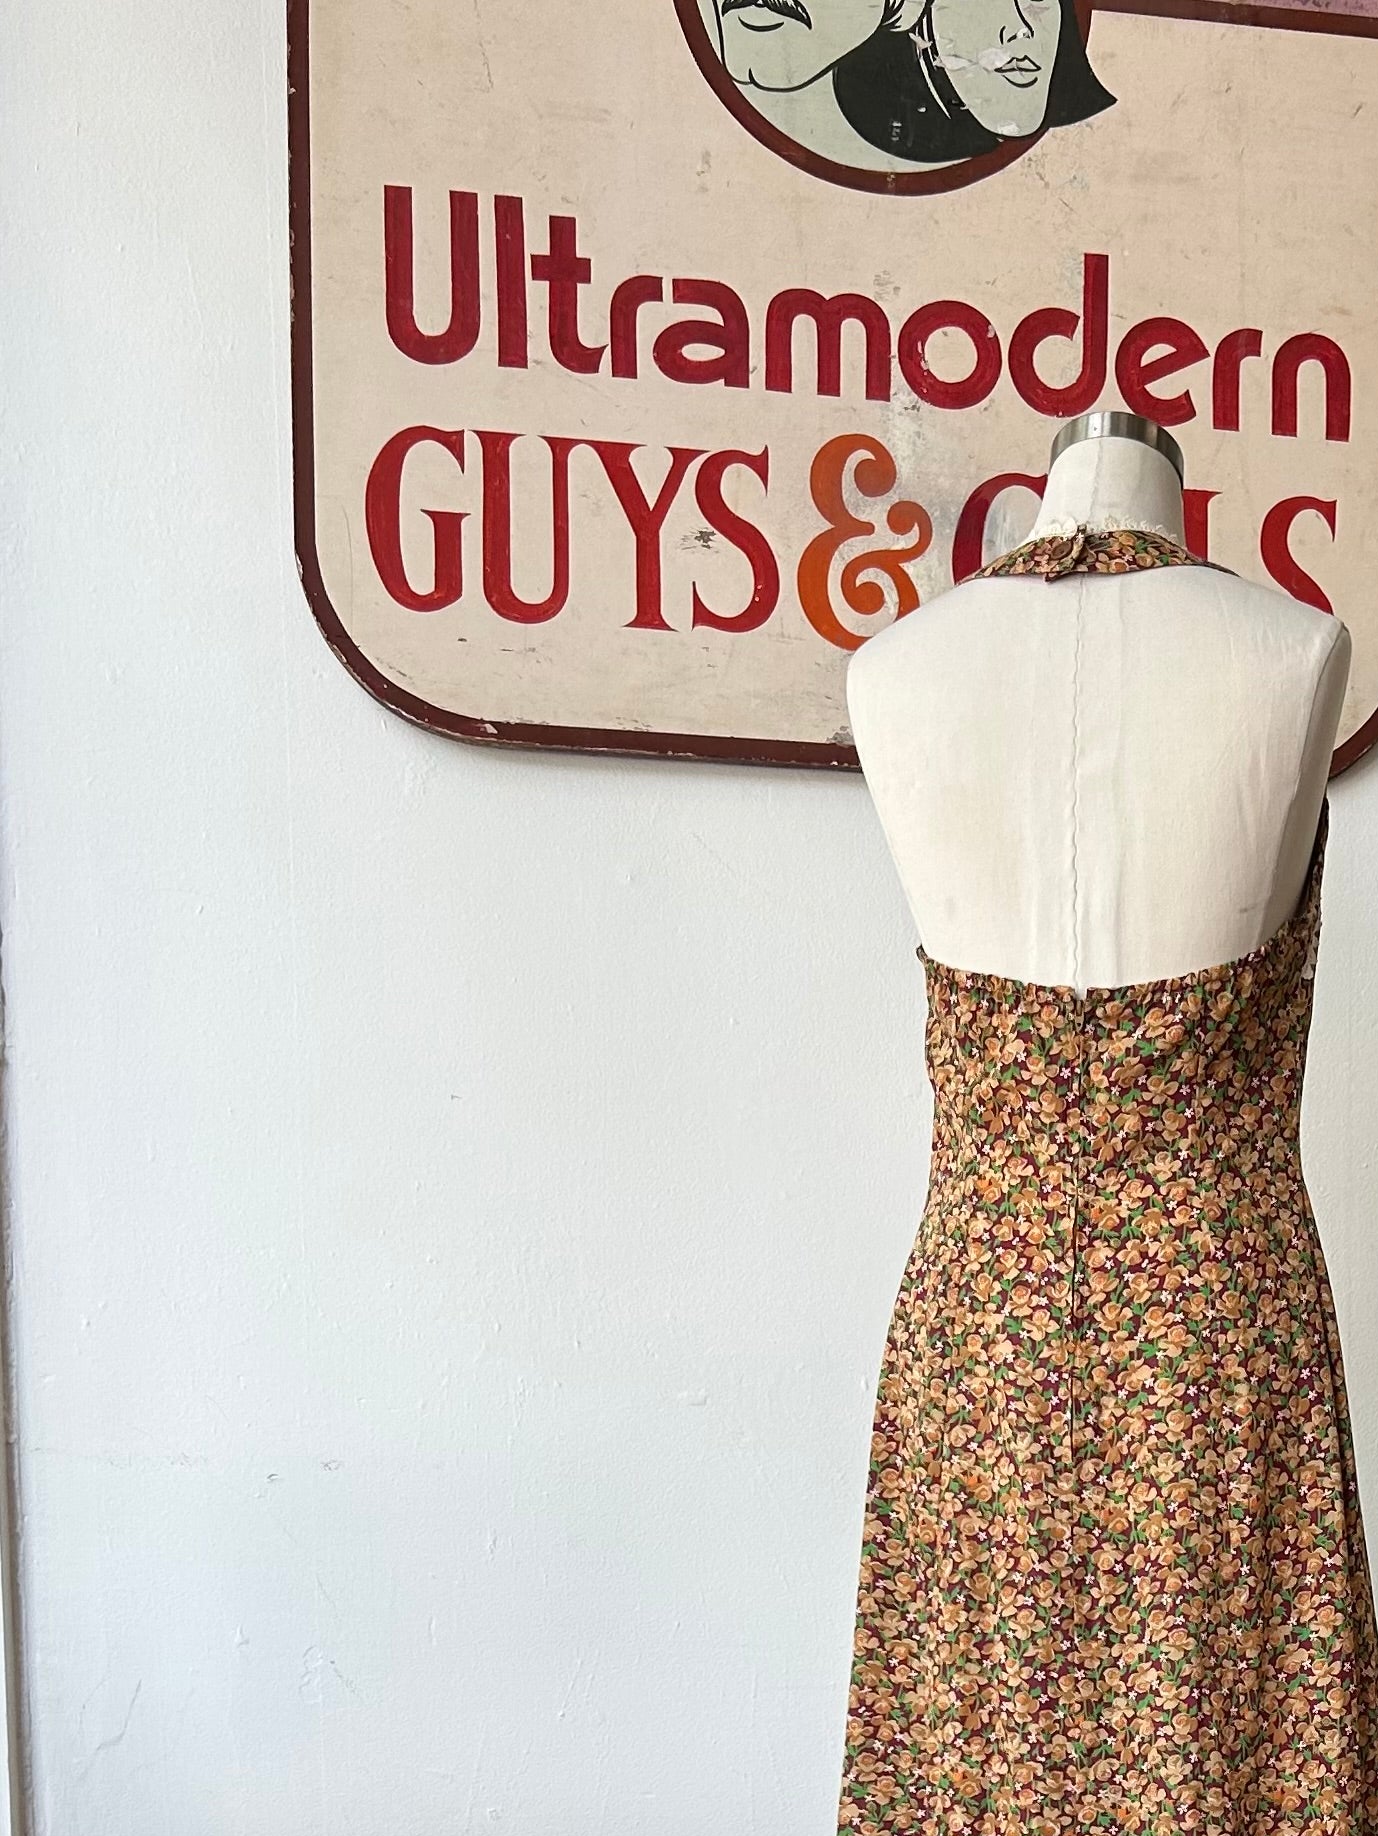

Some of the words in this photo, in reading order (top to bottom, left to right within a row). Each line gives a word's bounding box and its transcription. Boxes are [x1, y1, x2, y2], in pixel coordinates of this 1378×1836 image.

[383, 184, 1352, 442] Ultramodern
[365, 425, 781, 633] GUYS
[796, 433, 935, 652] &
